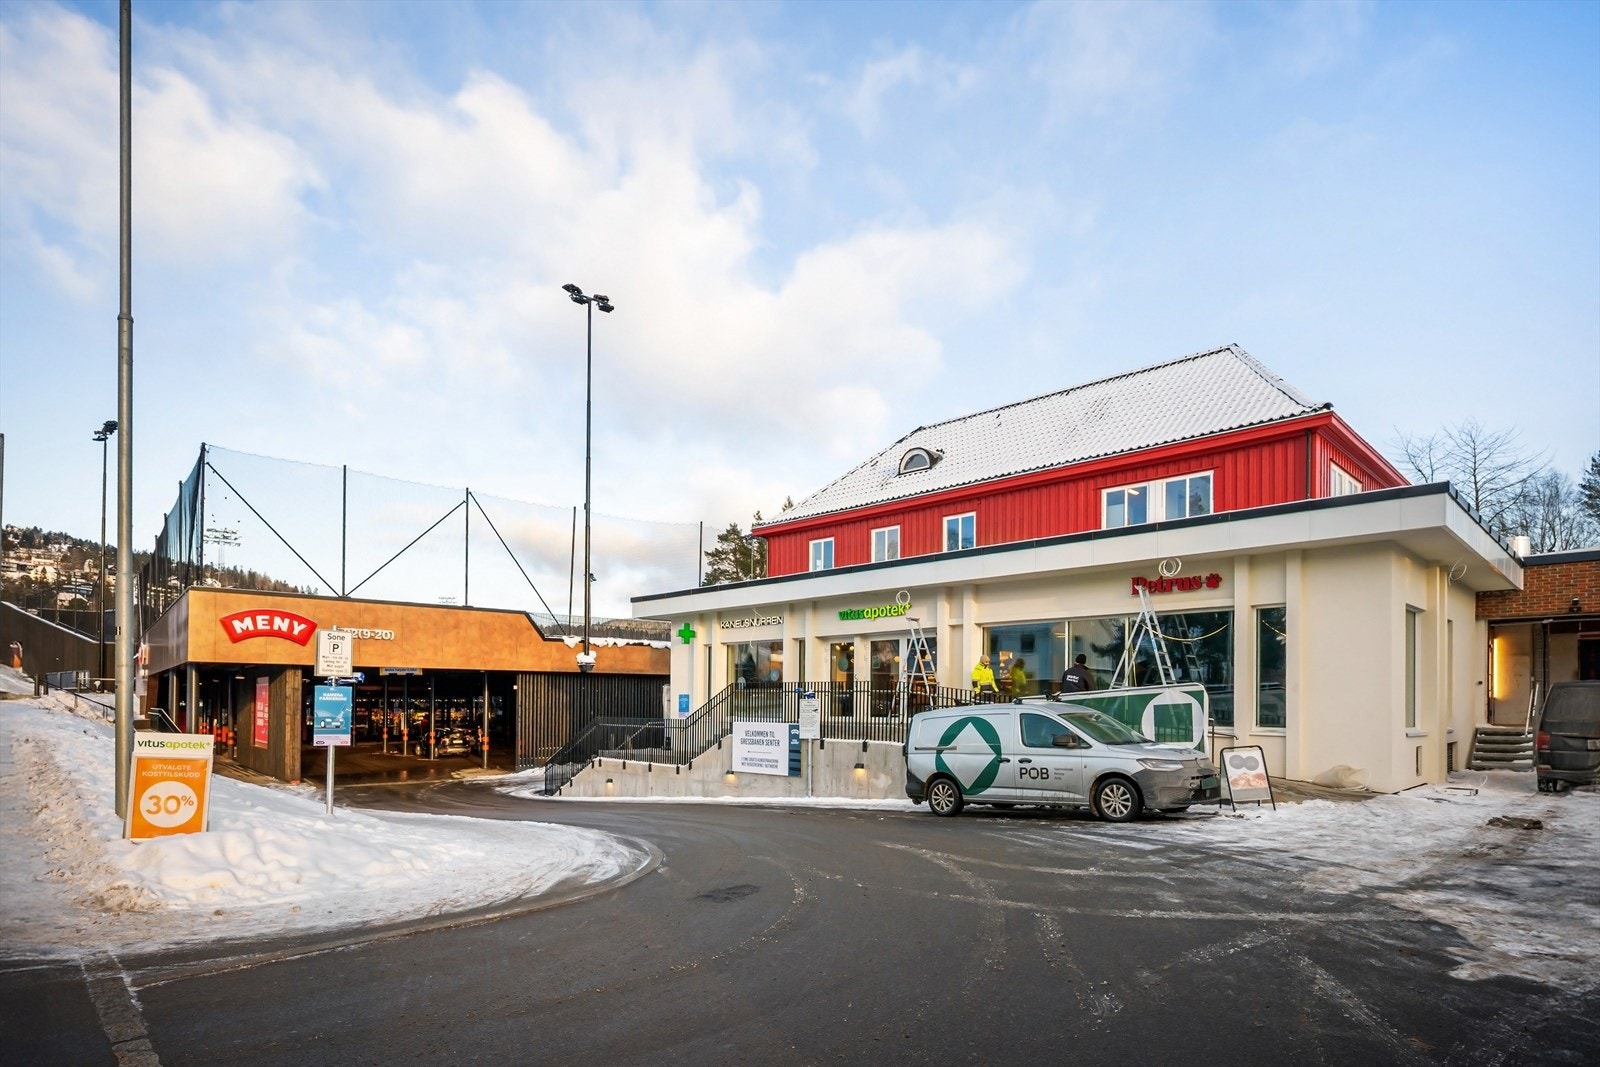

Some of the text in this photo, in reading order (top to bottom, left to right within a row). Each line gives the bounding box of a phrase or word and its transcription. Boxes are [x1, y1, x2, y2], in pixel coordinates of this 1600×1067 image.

[1131, 575, 1202, 595] Petrus
[232, 615, 307, 635] MENY
[327, 633, 346, 641] Sone
[332, 643, 340, 652] P
[765, 739, 780, 747] SENTER
[142, 770, 200, 778] KOSTTILSKUDD
[1020, 767, 1049, 780] POB
[145, 795, 194, 815] 30%
